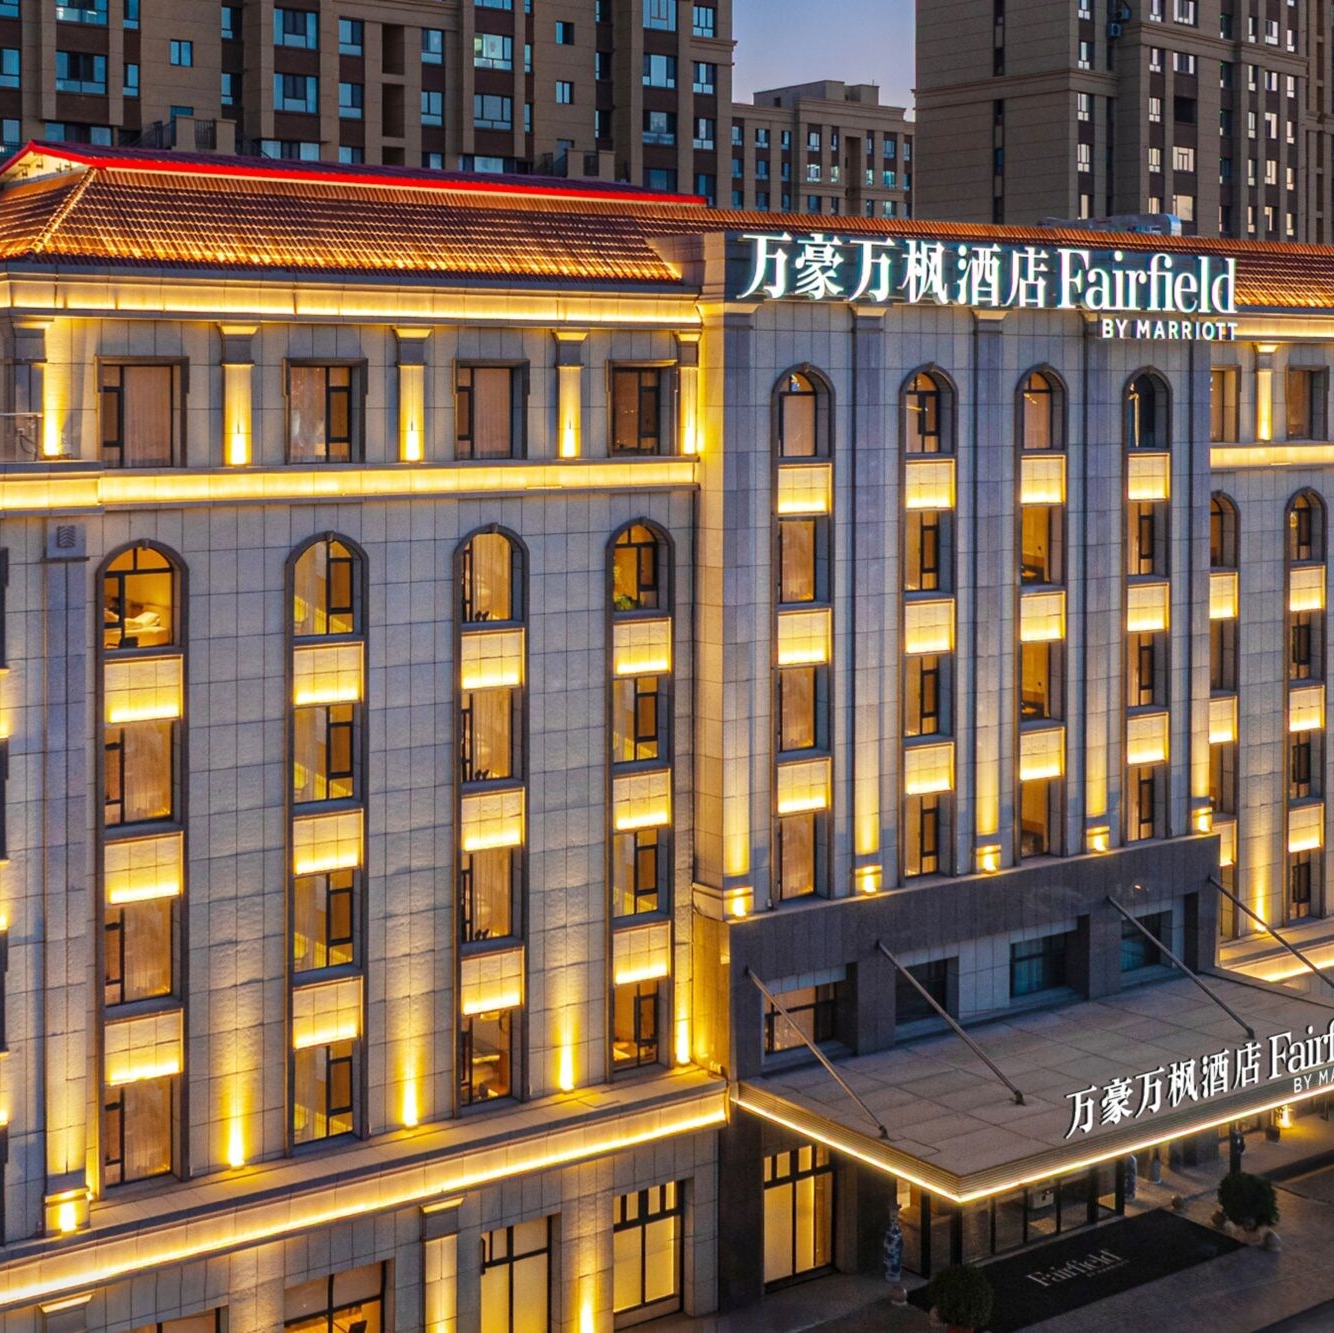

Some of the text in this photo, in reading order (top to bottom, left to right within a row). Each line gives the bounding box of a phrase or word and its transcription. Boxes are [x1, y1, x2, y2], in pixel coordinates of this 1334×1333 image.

[741, 233, 1238, 314] 万豪万枫酒店 Fairfield
[1101, 318, 1238, 341] BY MARRIOTT
[1064, 1042, 1262, 1139] 万豪万枫酒店
[1293, 1073, 1312, 1094] BY
